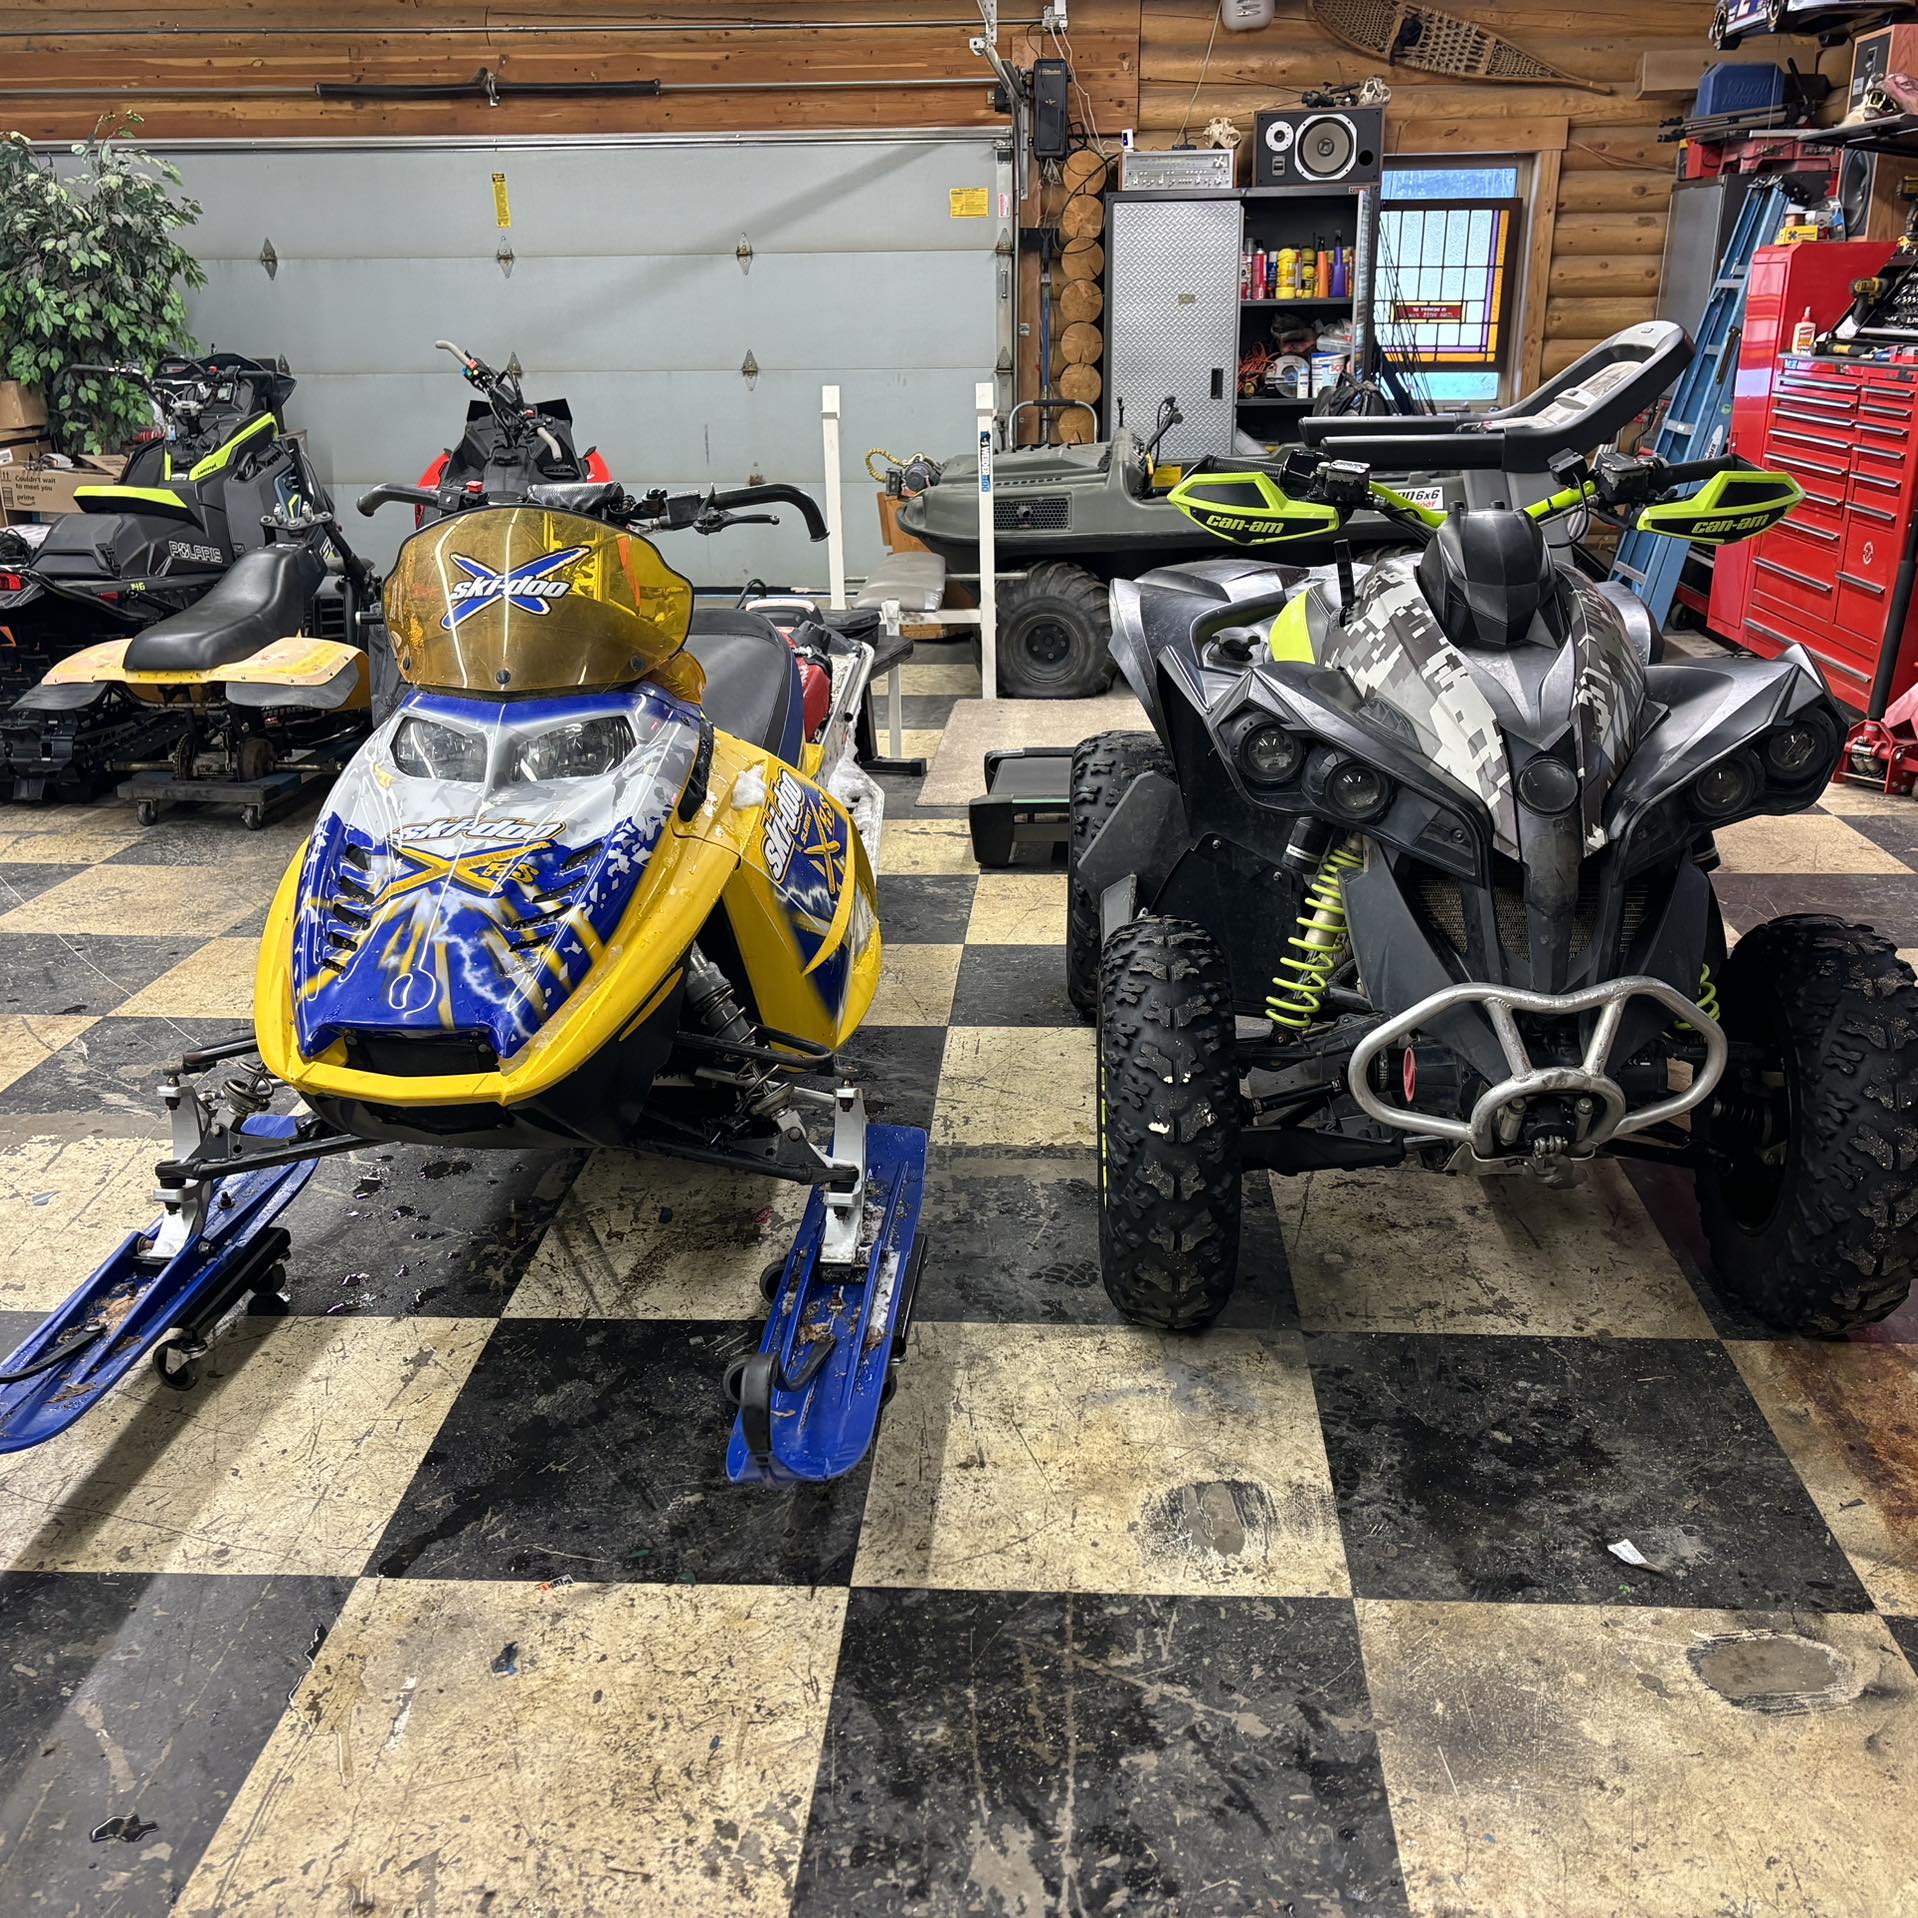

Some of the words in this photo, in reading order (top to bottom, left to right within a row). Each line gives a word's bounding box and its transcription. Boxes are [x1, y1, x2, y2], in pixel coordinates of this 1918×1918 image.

[15, 475, 41, 483] Couldn't
[1416, 489, 1440, 501] 6x6
[1206, 514, 1285, 534] can-am
[1691, 513, 1770, 534] can-am
[168, 540, 223, 564] POLARIS
[450, 574, 571, 600] ski-doo
[390, 815, 565, 842] ski-doo
[763, 769, 804, 881] ski-doo
